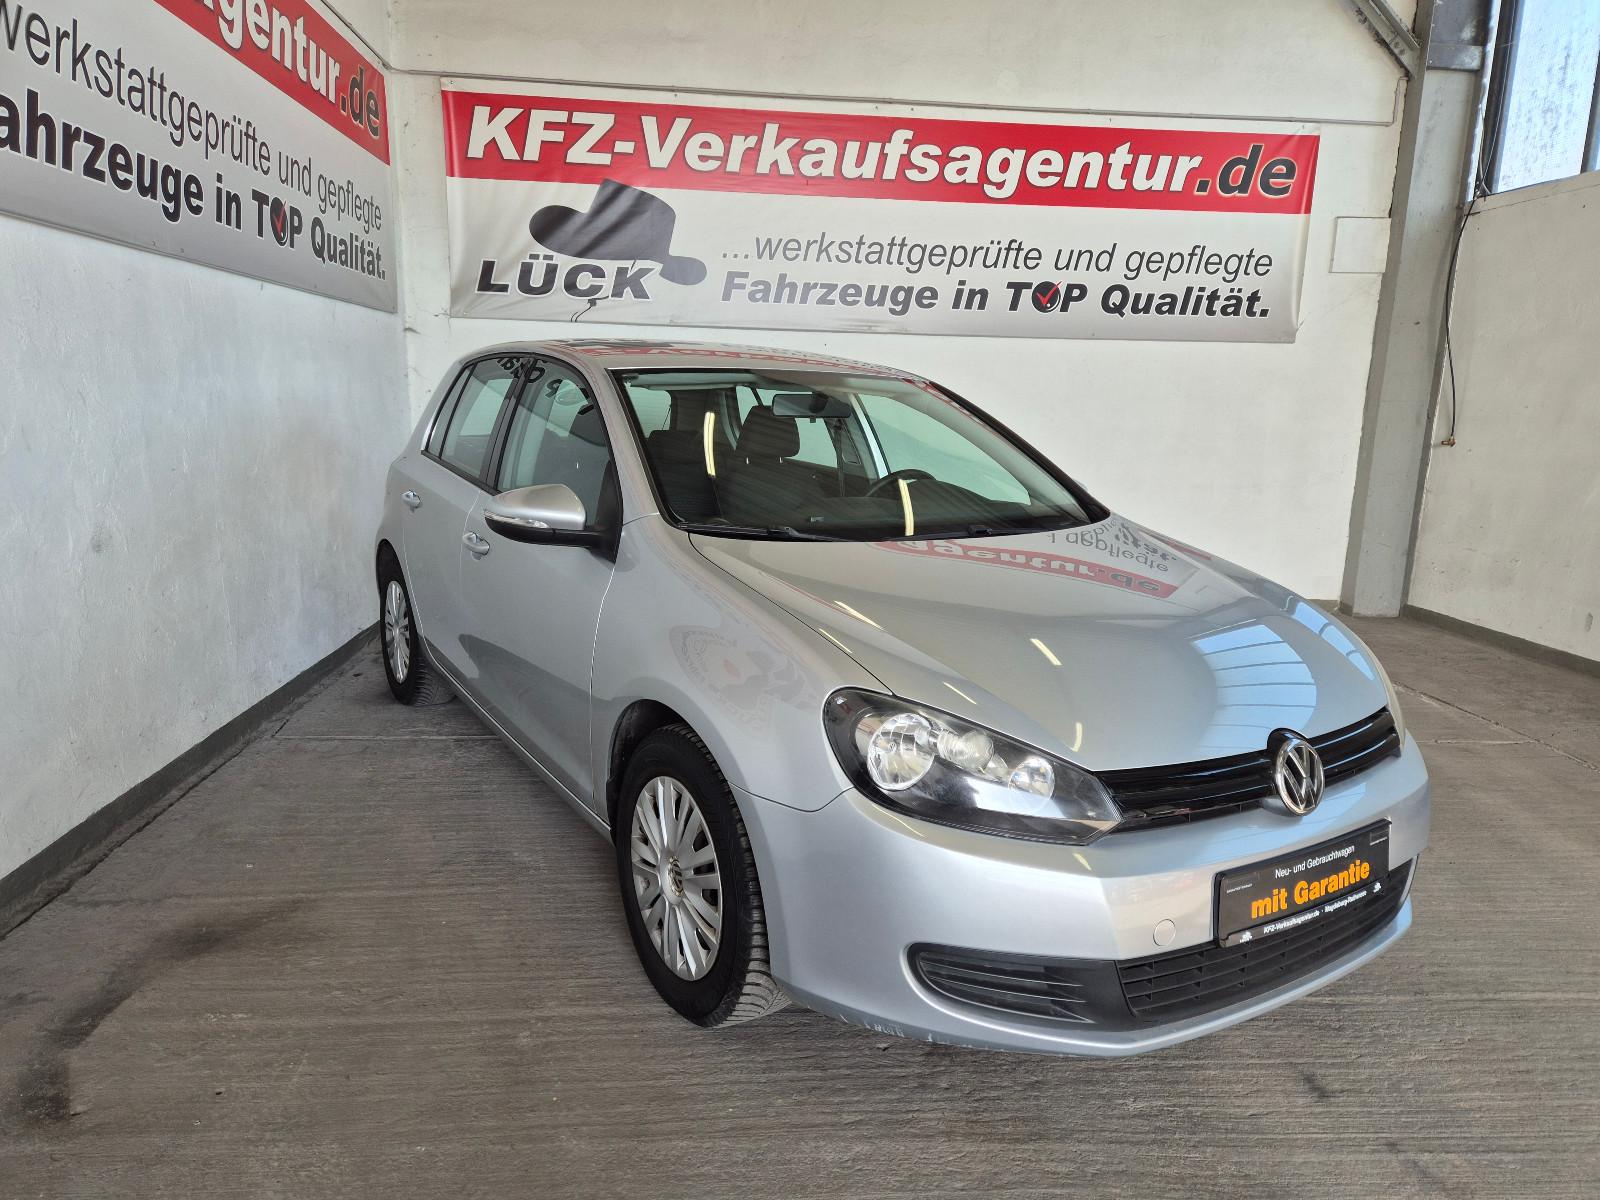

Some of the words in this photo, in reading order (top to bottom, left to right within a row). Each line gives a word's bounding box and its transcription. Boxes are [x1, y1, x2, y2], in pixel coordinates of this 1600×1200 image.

[203, 0, 380, 139] gentur.de
[466, 105, 1298, 199] KFZ-Verkaufsagentur.de
[278, 151, 312, 197] und
[317, 173, 382, 234] gepflegte
[215, 172, 242, 231] in
[251, 188, 303, 249] TOP
[310, 216, 386, 281] Qualität.
[476, 253, 653, 301] LÜCK
[1053, 243, 1116, 277] und
[1125, 245, 1273, 284] gepflegte
[720, 270, 939, 316] Fahrzeuge
[952, 279, 990, 311] in
[1005, 279, 1088, 314] TOP
[1100, 282, 1270, 319] Qualität.
[1251, 887, 1288, 919] mit
[1293, 859, 1371, 906] Garantie
[1274, 868, 1292, 879] Neu-
[1293, 860, 1306, 874] und
[1306, 845, 1355, 869] Gebrauchtwagen
